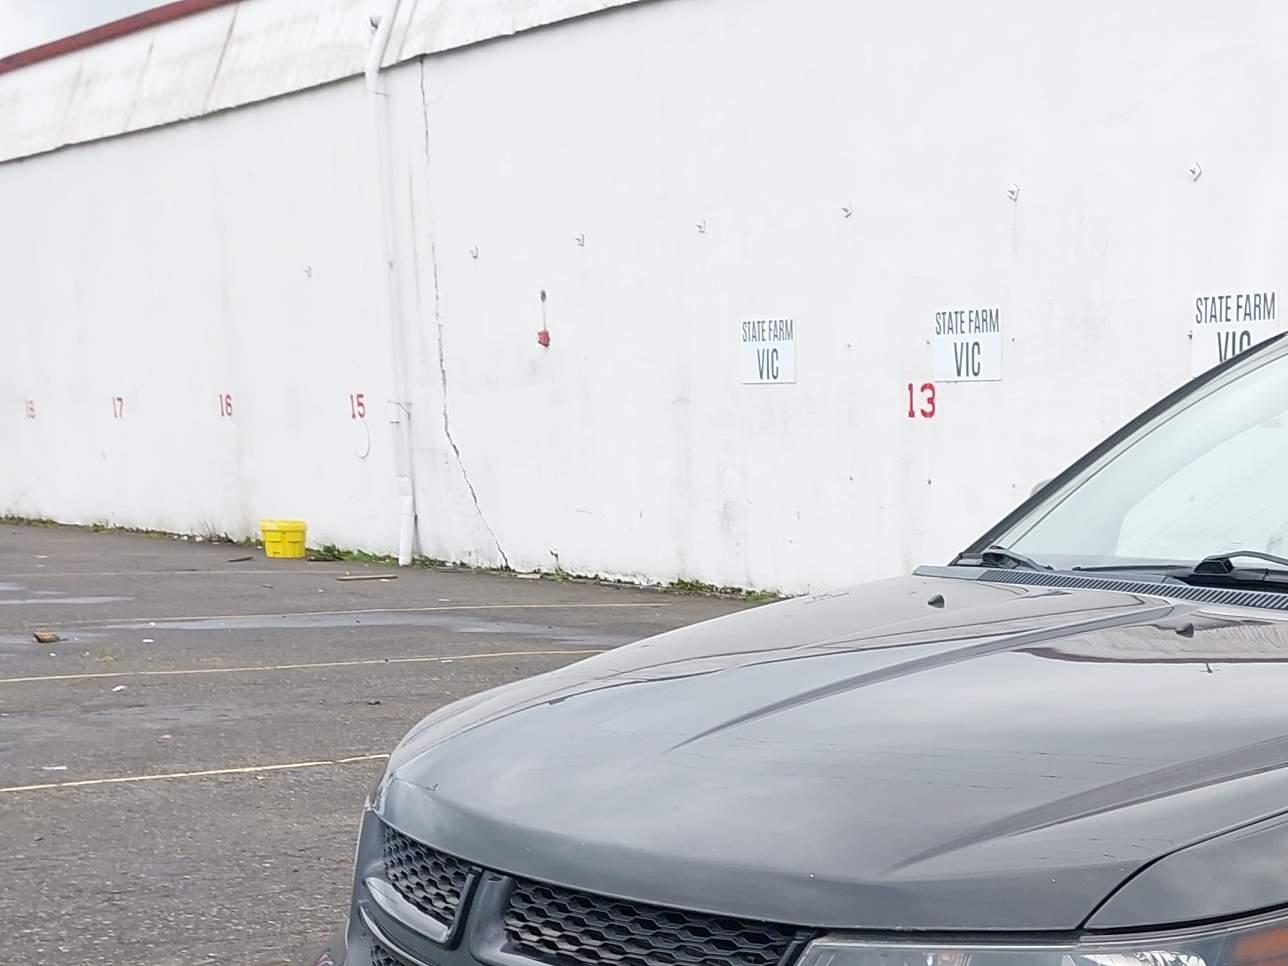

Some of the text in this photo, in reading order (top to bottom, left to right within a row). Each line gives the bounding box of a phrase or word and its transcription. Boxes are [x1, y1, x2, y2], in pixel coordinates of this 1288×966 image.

[935, 308, 1000, 335] STATE FARM
[1195, 292, 1276, 324] STATE FARM
[742, 319, 794, 342] STATE FARM
[756, 348, 779, 380] VIC
[953, 341, 981, 377] VIC
[112, 397, 124, 418] 17
[219, 394, 232, 417] 16
[350, 393, 366, 419] 15
[907, 382, 936, 418] 13
